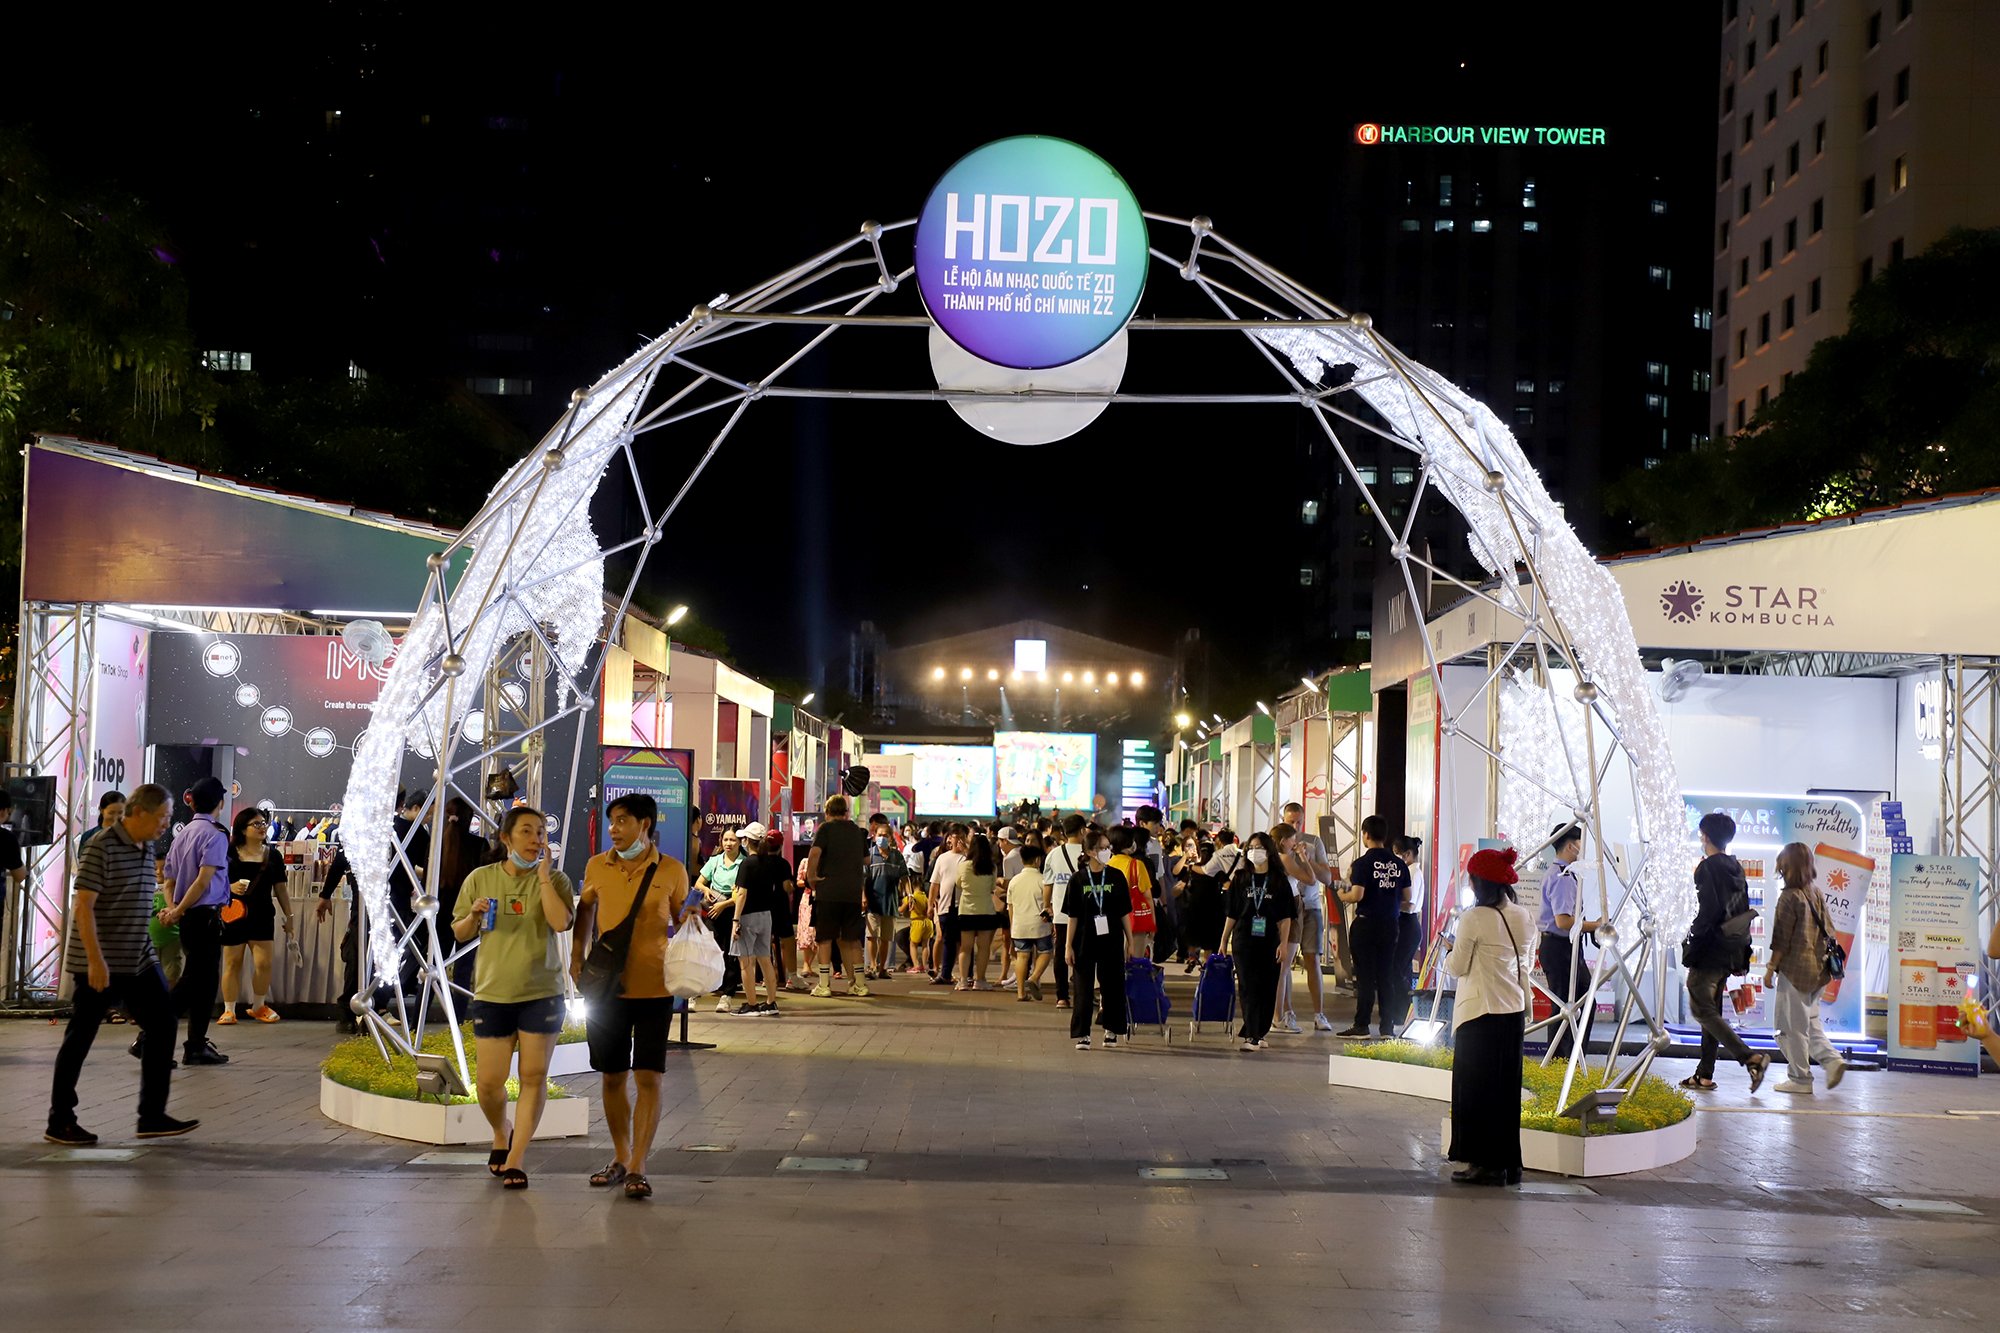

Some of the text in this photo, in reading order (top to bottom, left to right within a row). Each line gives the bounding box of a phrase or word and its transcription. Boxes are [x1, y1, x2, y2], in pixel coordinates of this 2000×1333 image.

[1380, 126, 1606, 145] HARBOUR VIEW TOWER
[944, 192, 1119, 265] HOZO
[944, 265, 958, 286] LỄ
[961, 269, 981, 290] HỘI
[983, 269, 1003, 288] ÂM
[1006, 272, 1039, 292] NHẠC
[1042, 271, 1074, 291] QUỐC
[1076, 271, 1093, 291] TẾ
[943, 292, 984, 311] THÀNH
[987, 292, 1014, 313] PHỐ
[1015, 293, 1033, 313] HỒ
[1034, 296, 1056, 314] CHÍ
[1058, 298, 1090, 315] MINH
[1725, 585, 1818, 609] STAR
[1710, 611, 1835, 626] KOMBUCHA
[117, 665, 129, 680] Shop
[324, 700, 345, 709] Create
[345, 701, 356, 709] the
[715, 814, 747, 825] YAMAHA
[1786, 802, 1843, 822] Sống Trendy
[1794, 818, 1859, 840] Uống Healthy
[1824, 893, 1850, 910] TAR
